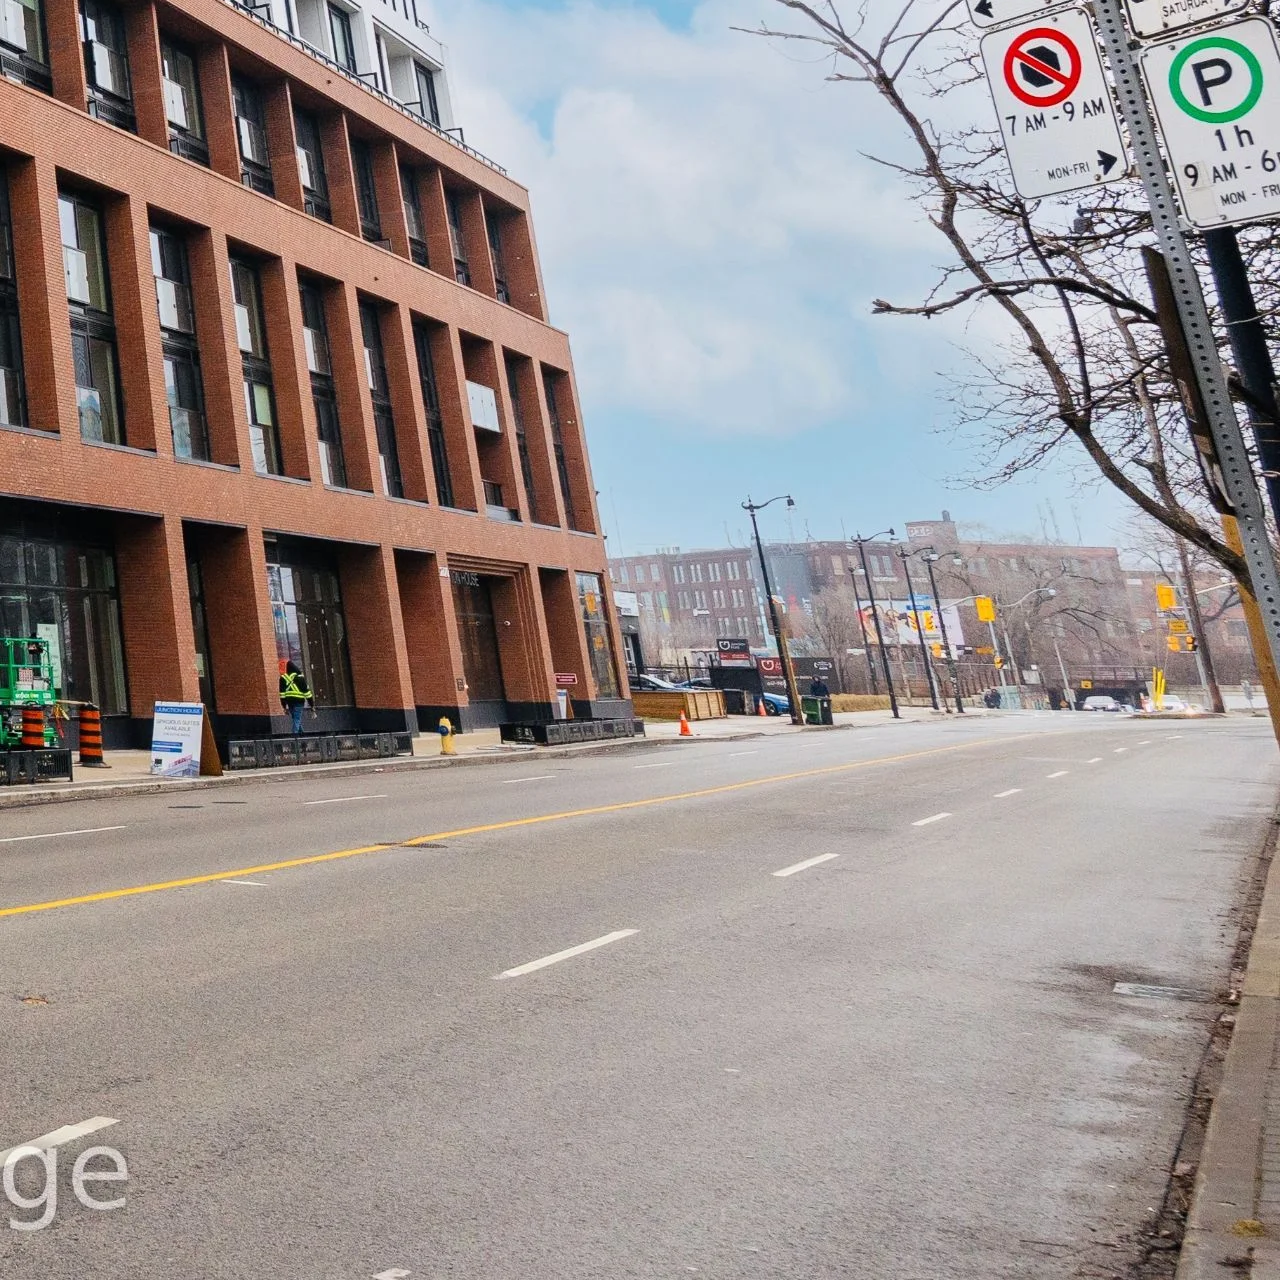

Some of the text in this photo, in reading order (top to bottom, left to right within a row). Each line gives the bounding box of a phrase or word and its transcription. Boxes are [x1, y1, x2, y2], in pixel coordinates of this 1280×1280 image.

[1191, 58, 1233, 106] P
[1005, 115, 1017, 136] 7
[1025, 112, 1046, 133] AM
[1063, 101, 1074, 121] 9
[1083, 97, 1106, 119] AM
[1215, 125, 1254, 151] 1 h
[1047, 161, 1091, 180] MON-FRI
[1184, 164, 1198, 187] 9
[1212, 162, 1238, 183] AM
[1220, 191, 1246, 206] MON
